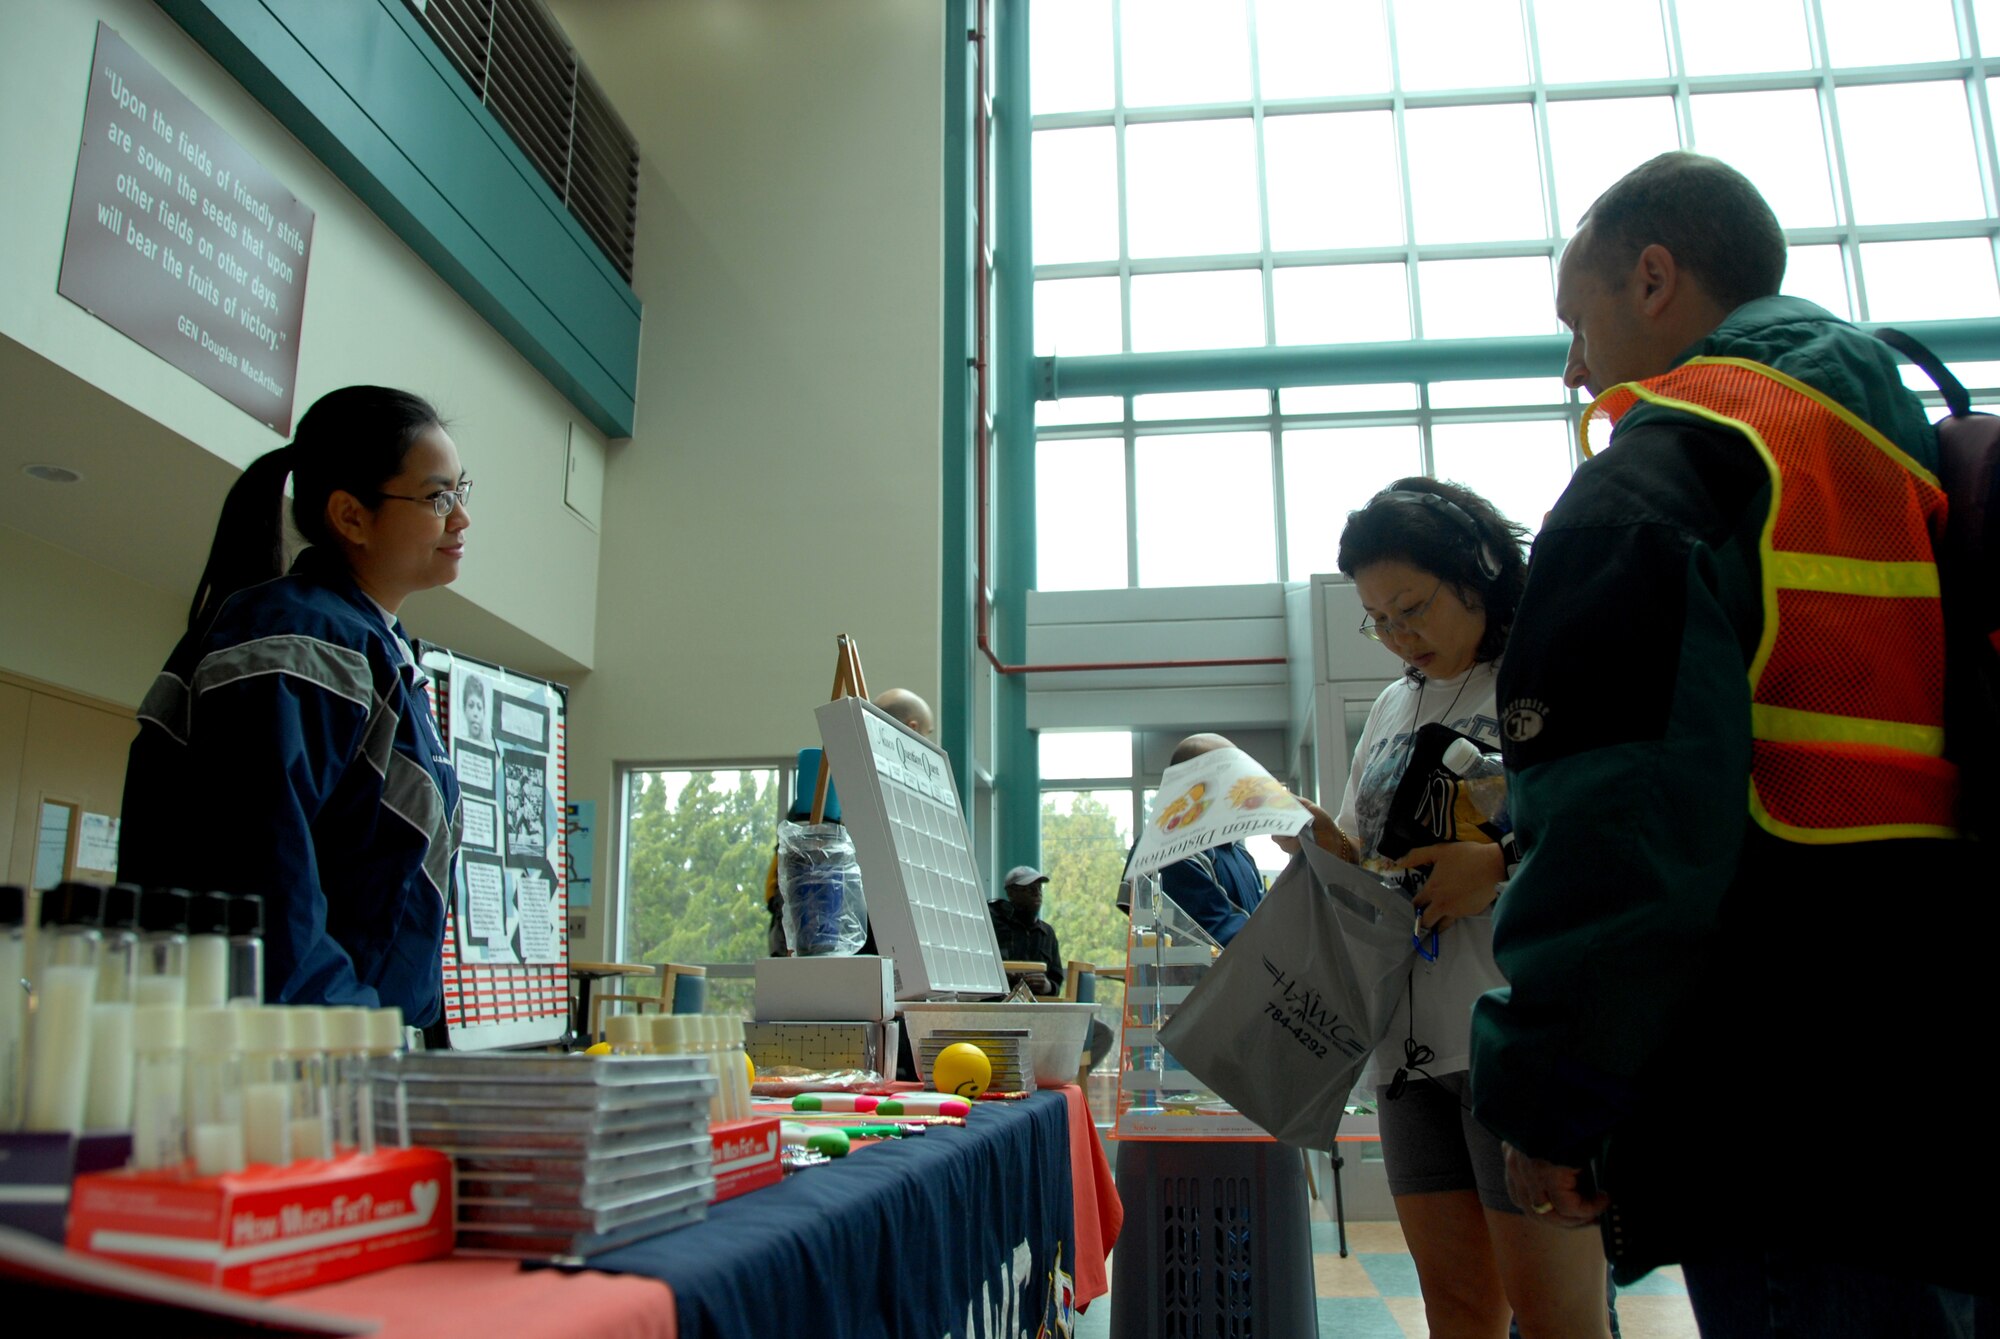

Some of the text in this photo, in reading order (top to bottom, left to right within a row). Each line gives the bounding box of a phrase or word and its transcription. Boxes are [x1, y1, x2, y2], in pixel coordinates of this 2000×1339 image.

[104, 66, 304, 256] “Upon the fields of friendly strife
[108, 121, 293, 284] are sown the seeds that upon
[97, 202, 123, 236] will
[127, 218, 158, 261] bear
[162, 246, 183, 280] the
[187, 264, 220, 307] fruits
[223, 297, 238, 318] of
[117, 173, 154, 214] other
[158, 200, 194, 246] fields
[198, 236, 213, 261] on
[218, 251, 248, 286] other
[177, 314, 284, 398] GEN Douglas MacArthur
[1134, 828, 1215, 869] Distortion
[1221, 817, 1295, 835] Portion
[1264, 1001, 1328, 1059] 784-4292
[1271, 971, 1357, 1044] HAWC
